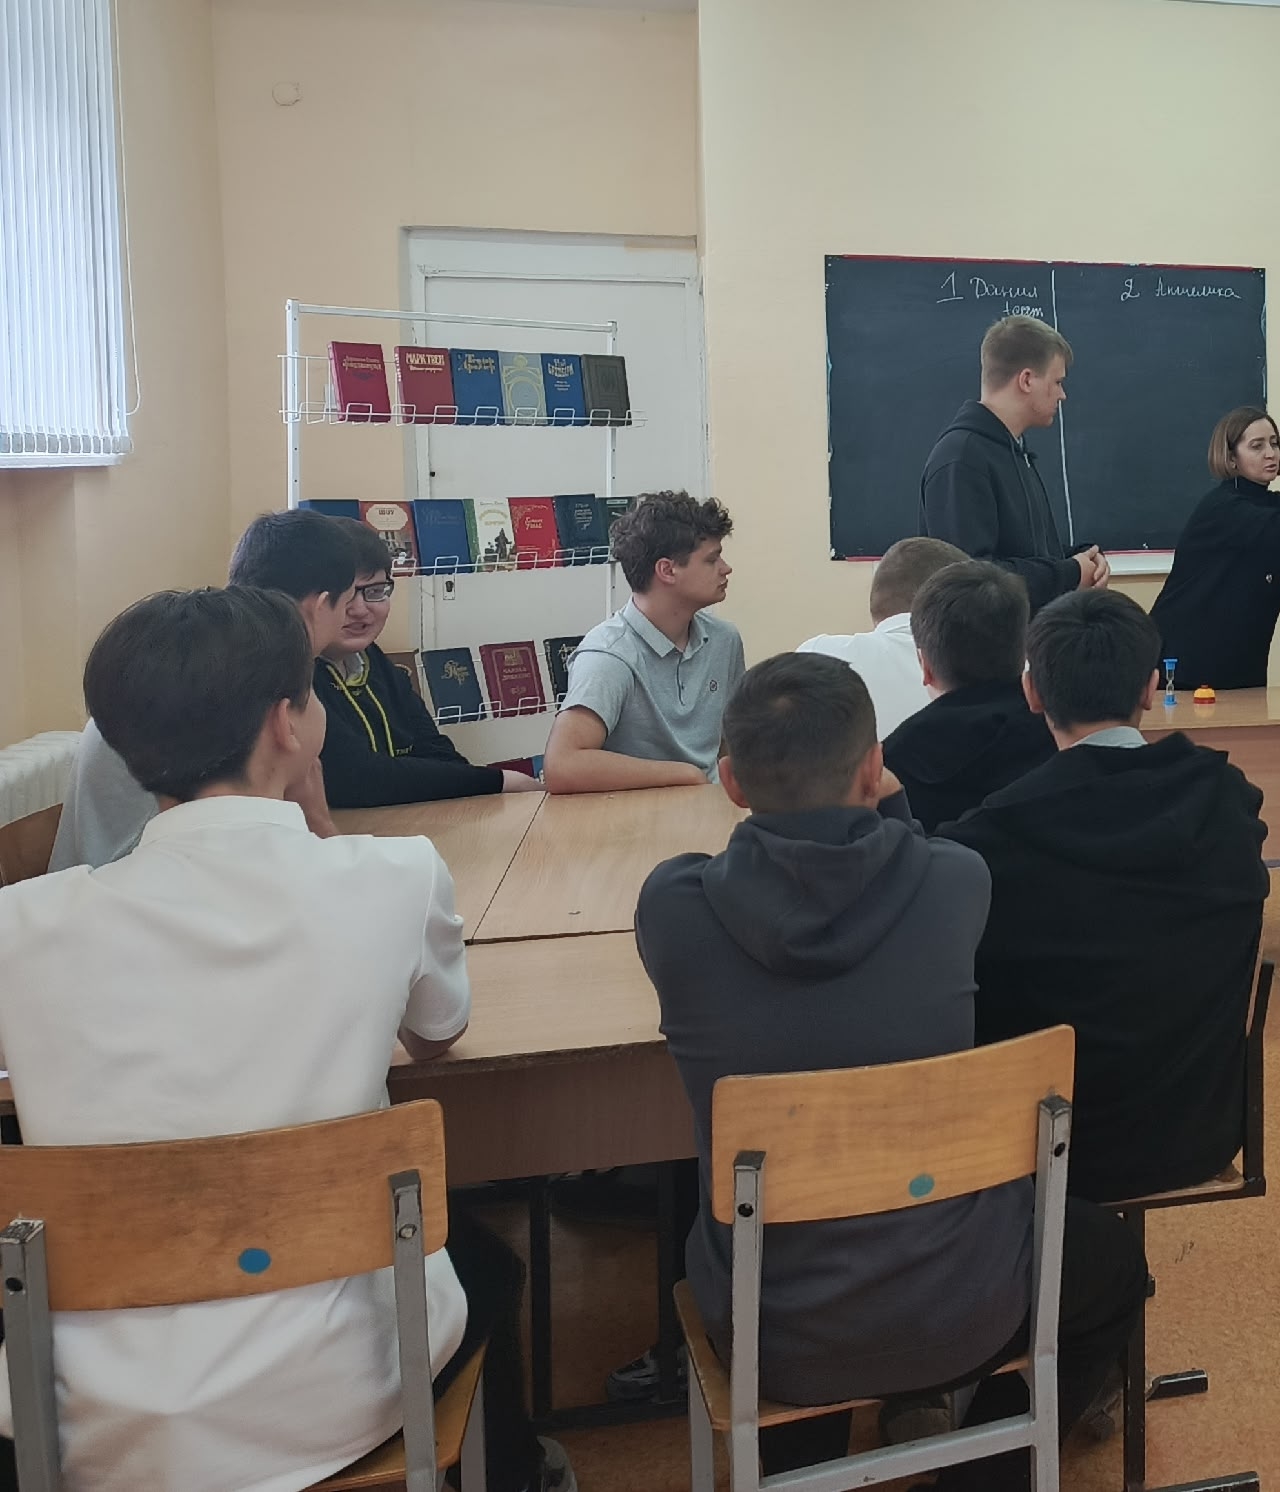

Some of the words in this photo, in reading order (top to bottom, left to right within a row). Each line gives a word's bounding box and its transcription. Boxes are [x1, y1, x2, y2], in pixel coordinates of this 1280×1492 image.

[937, 271, 963, 302] 1
[1120, 276, 1140, 299] 2
[406, 353, 427, 364] МАРК
